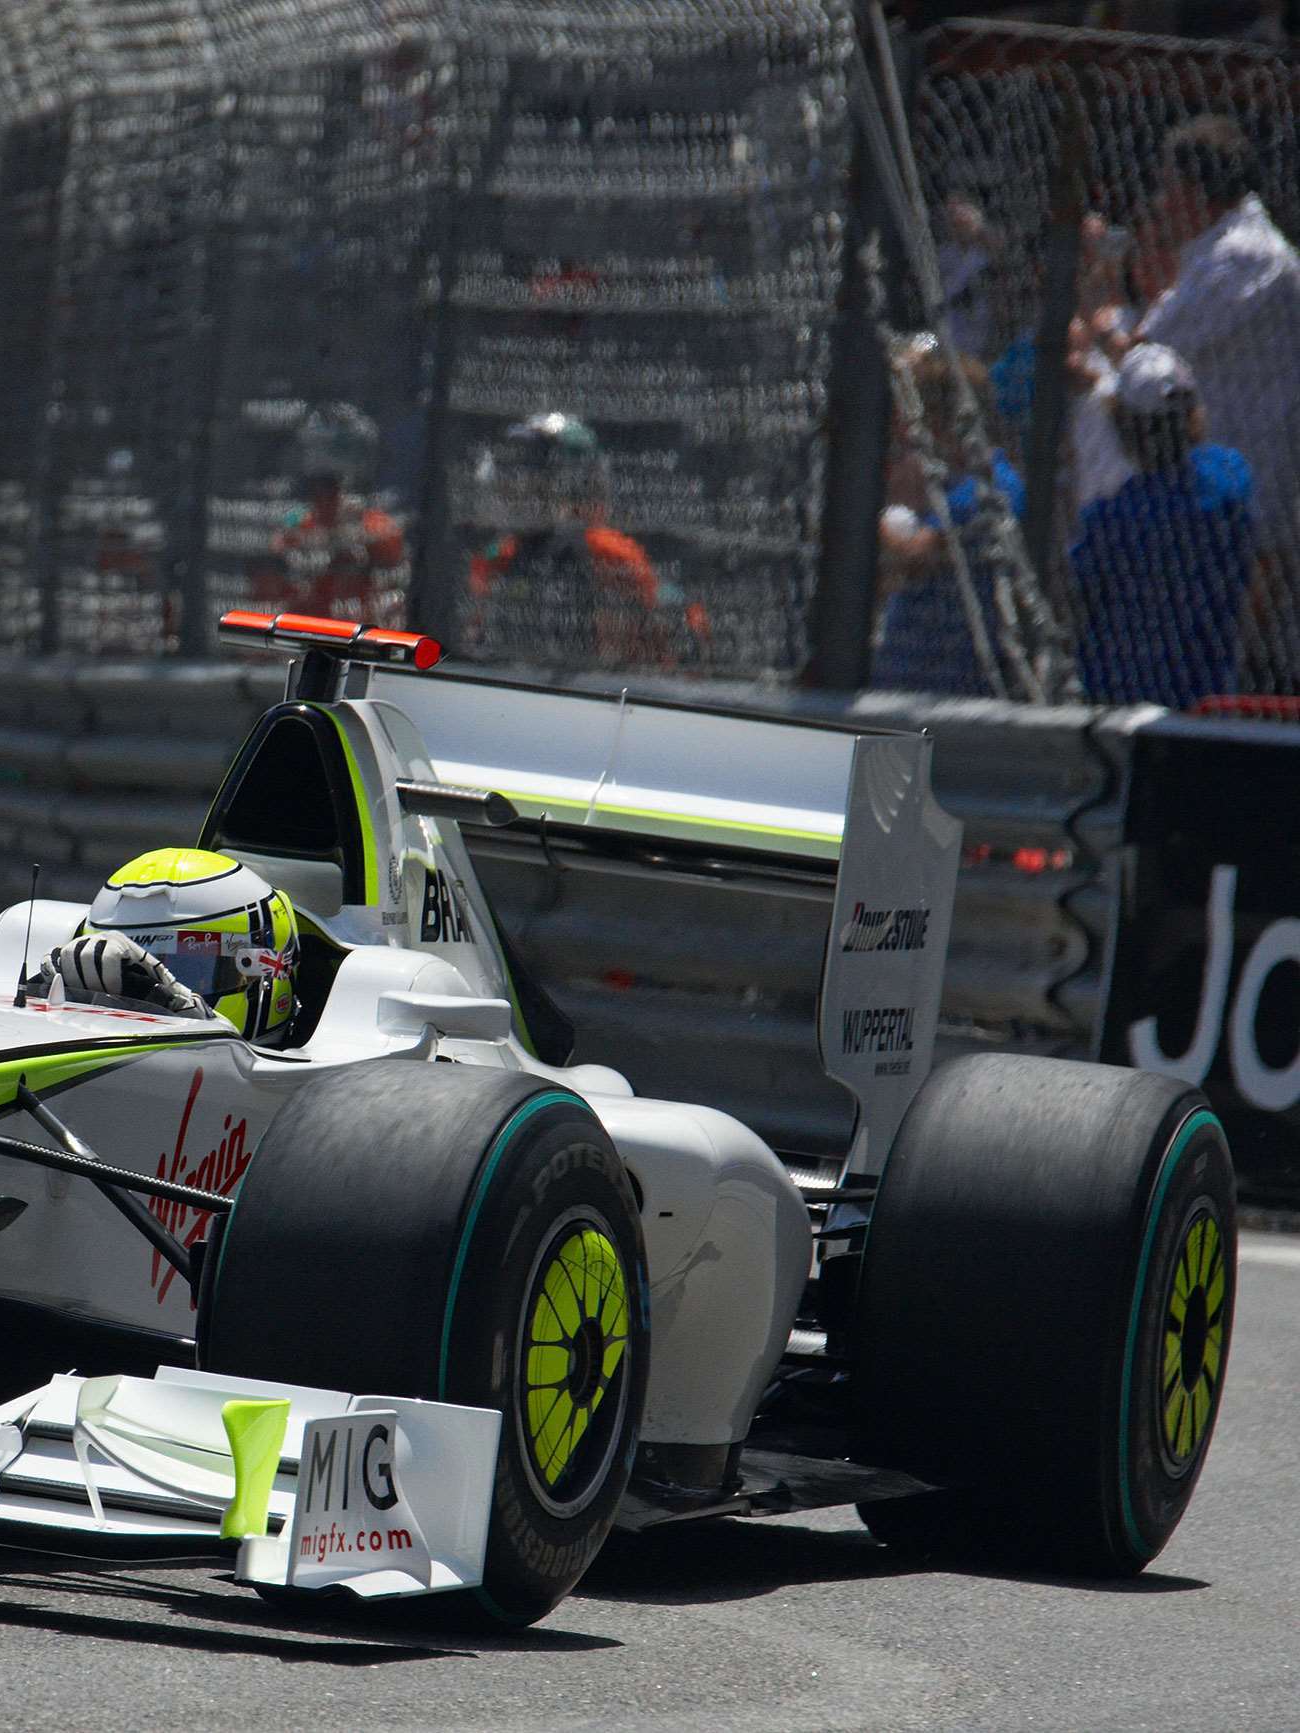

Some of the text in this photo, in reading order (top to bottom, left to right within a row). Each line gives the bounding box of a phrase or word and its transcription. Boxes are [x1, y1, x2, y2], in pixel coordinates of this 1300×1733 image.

[842, 1007, 915, 1054] WUPPERTAL
[305, 1424, 399, 1513] MIG
[299, 1522, 413, 1562] migfx.com
